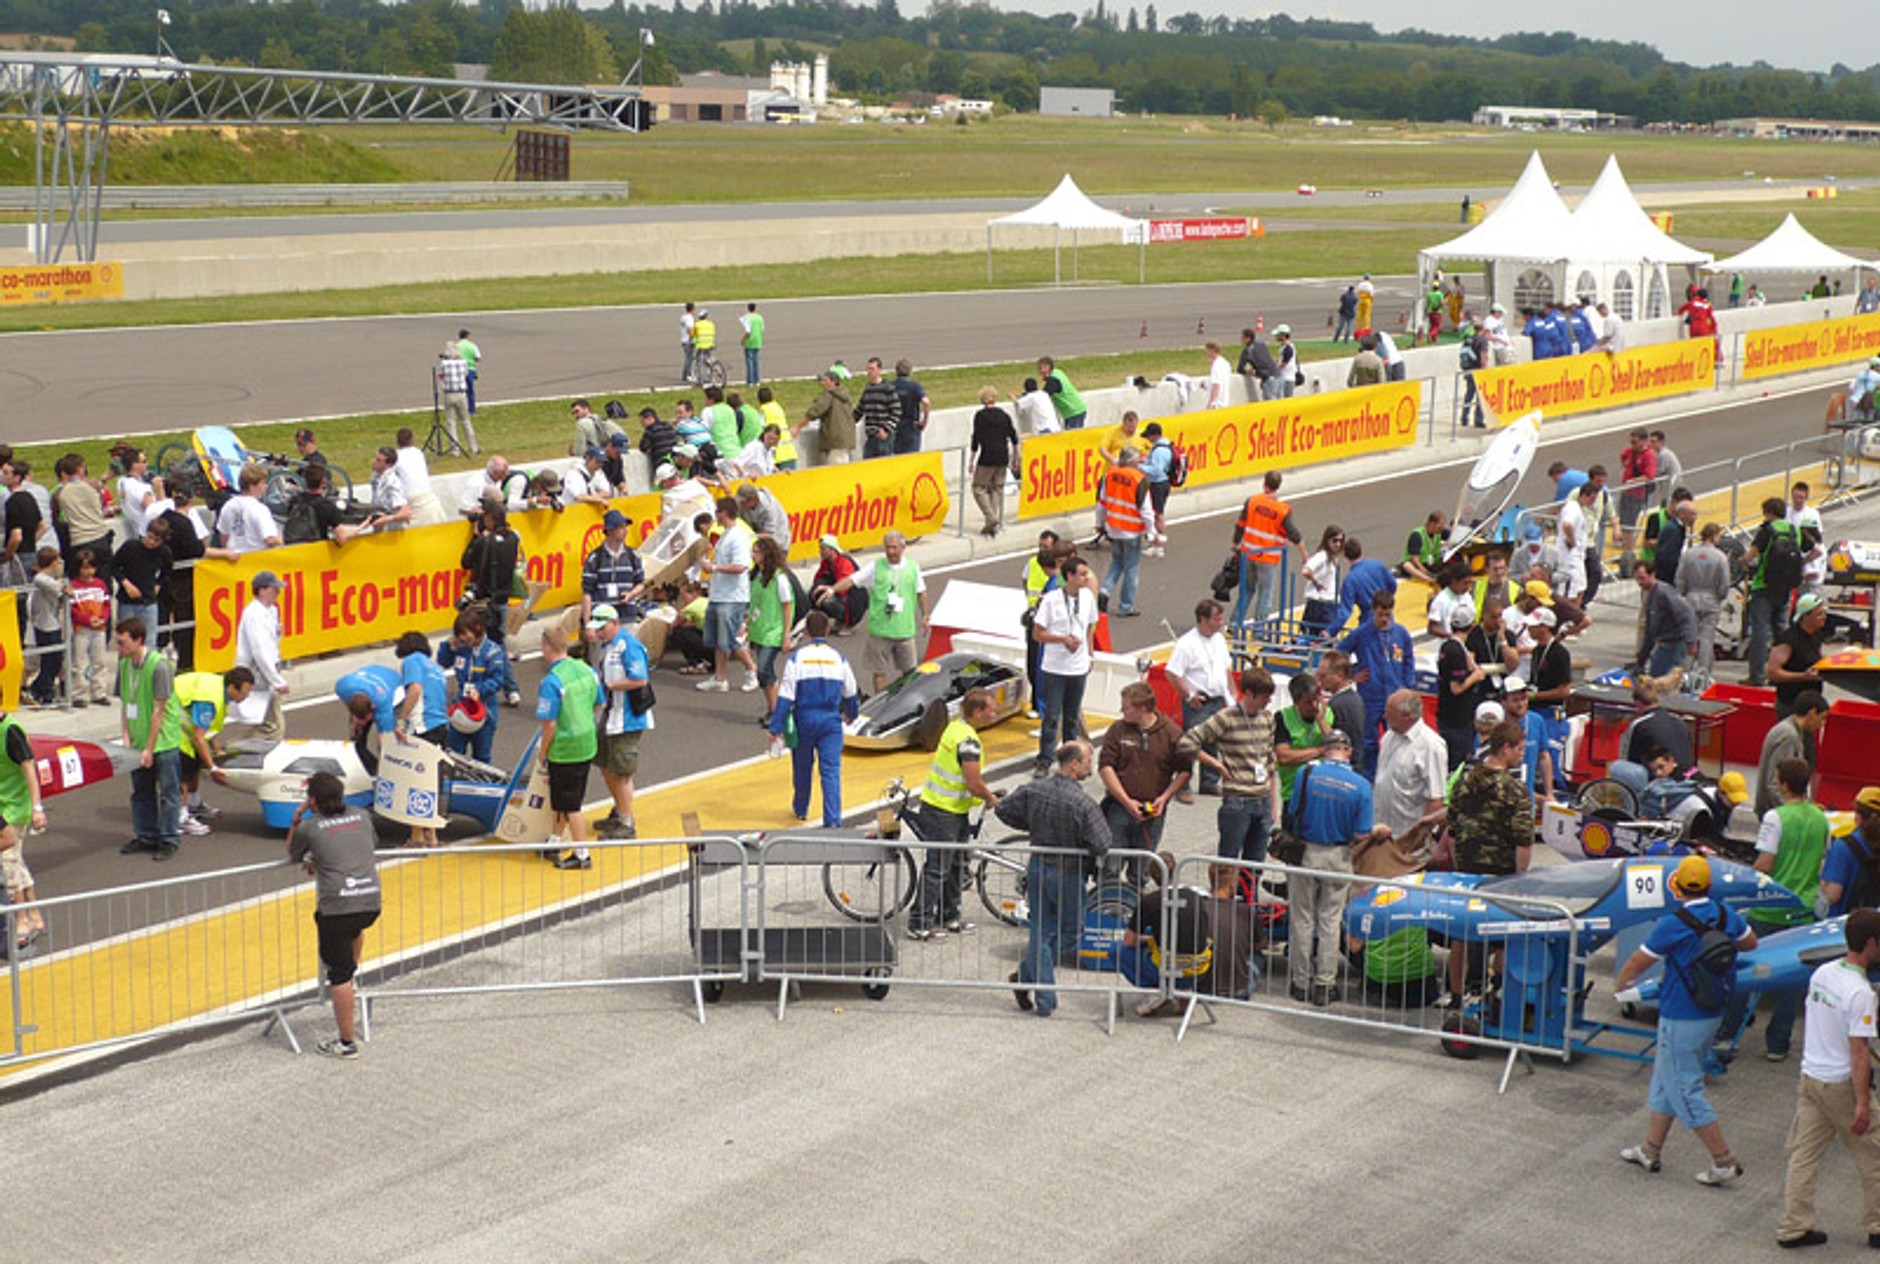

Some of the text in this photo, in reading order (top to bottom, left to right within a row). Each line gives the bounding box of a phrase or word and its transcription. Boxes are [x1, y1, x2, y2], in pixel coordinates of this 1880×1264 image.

[2, 267, 91, 289] co-marathon
[1507, 368, 1585, 413] Eco-marathon
[1248, 401, 1391, 463] Shell Eco-marathon
[1027, 449, 1077, 503] Shell
[786, 482, 899, 545] marathon
[209, 570, 305, 651] Sll
[1635, 876, 1656, 894] 90
